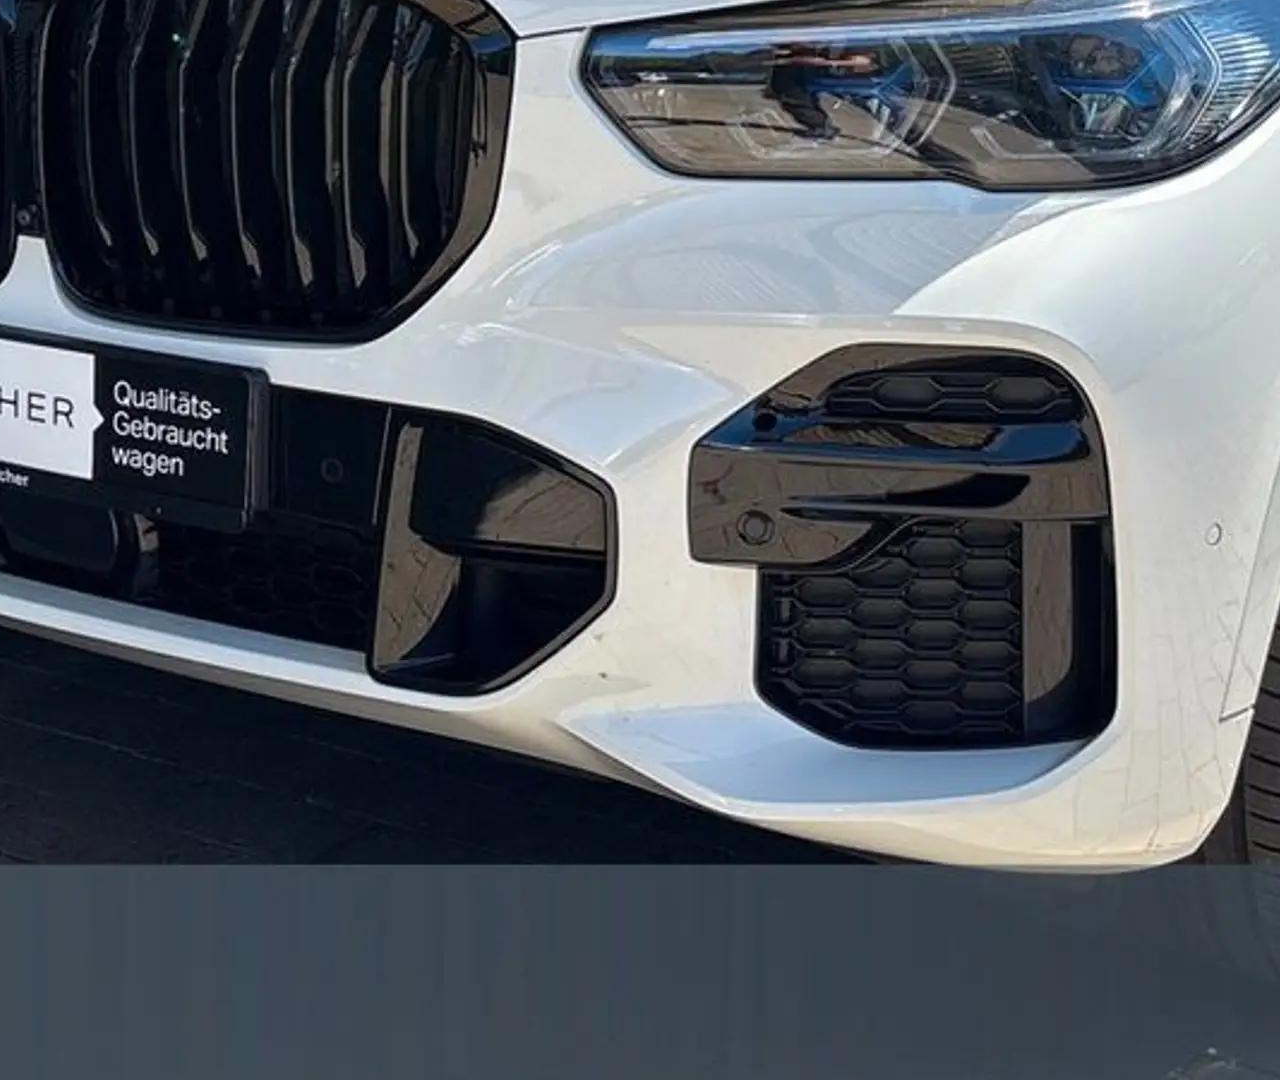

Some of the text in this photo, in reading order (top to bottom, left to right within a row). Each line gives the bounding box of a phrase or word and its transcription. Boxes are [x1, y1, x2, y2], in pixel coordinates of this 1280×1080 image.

[113, 381, 222, 419] Qualitäts-
[112, 413, 229, 454] Gebraucht
[112, 446, 184, 477] wagen
